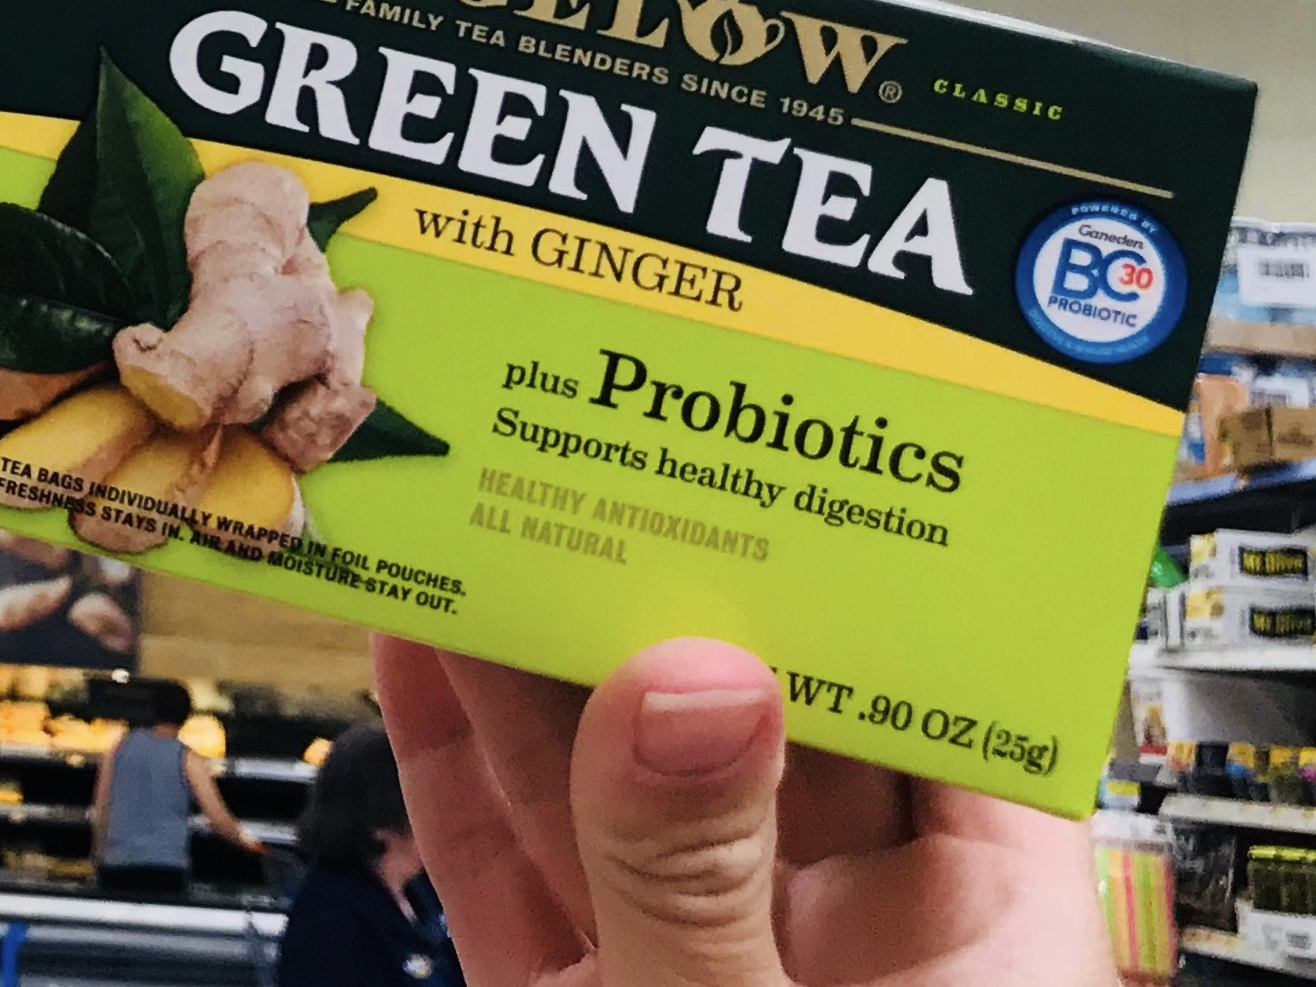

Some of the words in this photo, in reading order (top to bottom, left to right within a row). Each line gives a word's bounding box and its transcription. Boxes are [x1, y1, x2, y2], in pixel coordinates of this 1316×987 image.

[455, 19, 505, 48] TEA
[518, 35, 669, 85] BLENDERS
[681, 73, 767, 108] SINCE
[779, 96, 845, 125] 1945
[933, 78, 1065, 121] CLASSIC
[169, 10, 657, 214] GREEN
[692, 126, 974, 296] TEA
[414, 207, 515, 257] with
[530, 228, 744, 313] GINGER
[1071, 204, 1138, 221] POWERED
[1078, 224, 1144, 250] Ganeden
[1047, 294, 1138, 328] PROBIOTIC
[501, 359, 579, 399] plus
[589, 348, 965, 494] Probiotics
[0, 457, 32, 480] TEA
[38, 467, 84, 492] BAGS
[89, 480, 212, 527] INDIVIDUALLY
[216, 511, 303, 553] WRAPPED
[307, 537, 327, 557] IN
[332, 544, 370, 569] FOIL
[375, 557, 467, 597] POUCHES.
[478, 467, 586, 515] HEALTHY
[592, 495, 770, 563] ANTIOXIDANTS
[491, 407, 649, 472] Supports
[655, 443, 787, 509] healthy
[794, 477, 950, 548] digestion
[101, 504, 158, 534] STAYS
[161, 519, 184, 542] IN.
[189, 526, 220, 550] AIR
[222, 534, 263, 562] AND
[267, 547, 361, 588] MOISTURE
[366, 572, 412, 603] STAY
[415, 588, 459, 615] OUT.
[469, 502, 512, 535] ALL
[520, 515, 627, 565] NATURAL
[785, 670, 854, 714] WT
[857, 694, 913, 731] .90
[921, 708, 978, 749] OZ
[982, 720, 1060, 777] (25g)
